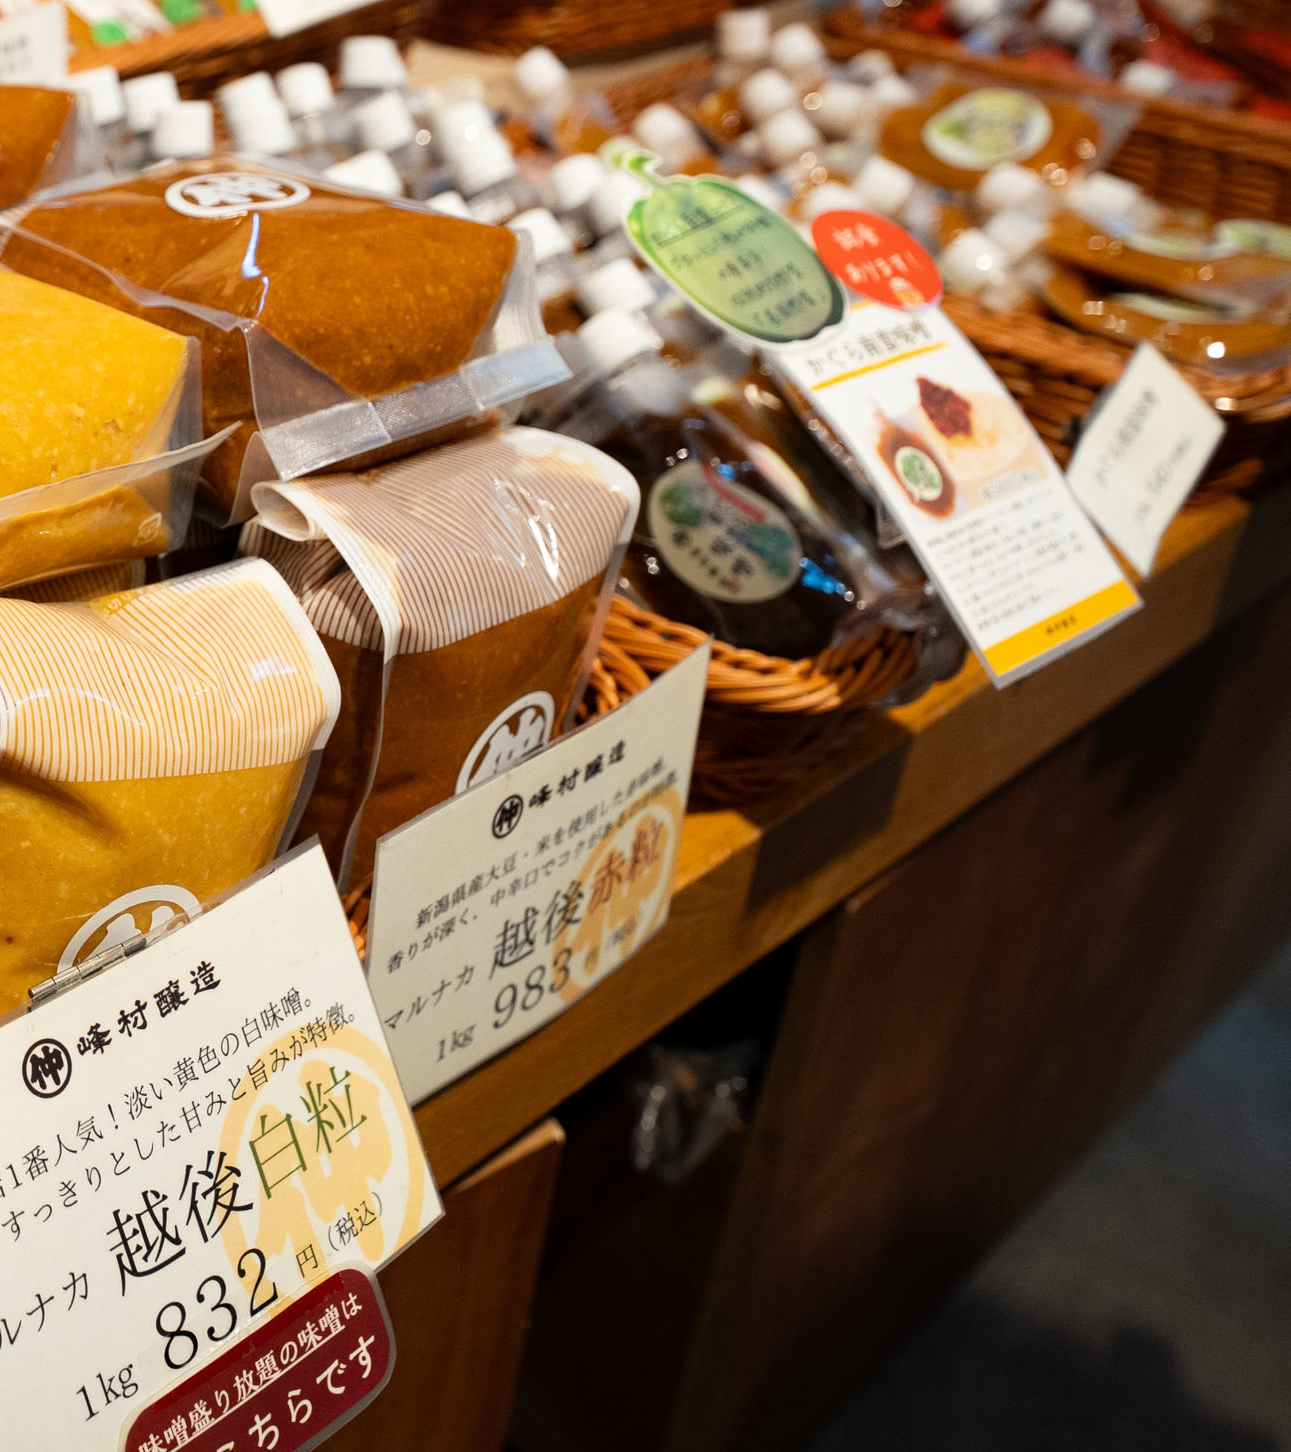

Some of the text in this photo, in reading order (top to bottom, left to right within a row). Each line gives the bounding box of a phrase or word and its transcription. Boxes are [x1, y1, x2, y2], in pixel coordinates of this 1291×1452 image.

[22, 960, 222, 1099] 仲 峰村醸造
[384, 964, 475, 1030] マルナカ
[492, 947, 573, 1031] 983
[105, 1064, 368, 1297] 越後白粒
[76, 1362, 140, 1422] 1kg
[155, 1246, 280, 1370] 832
